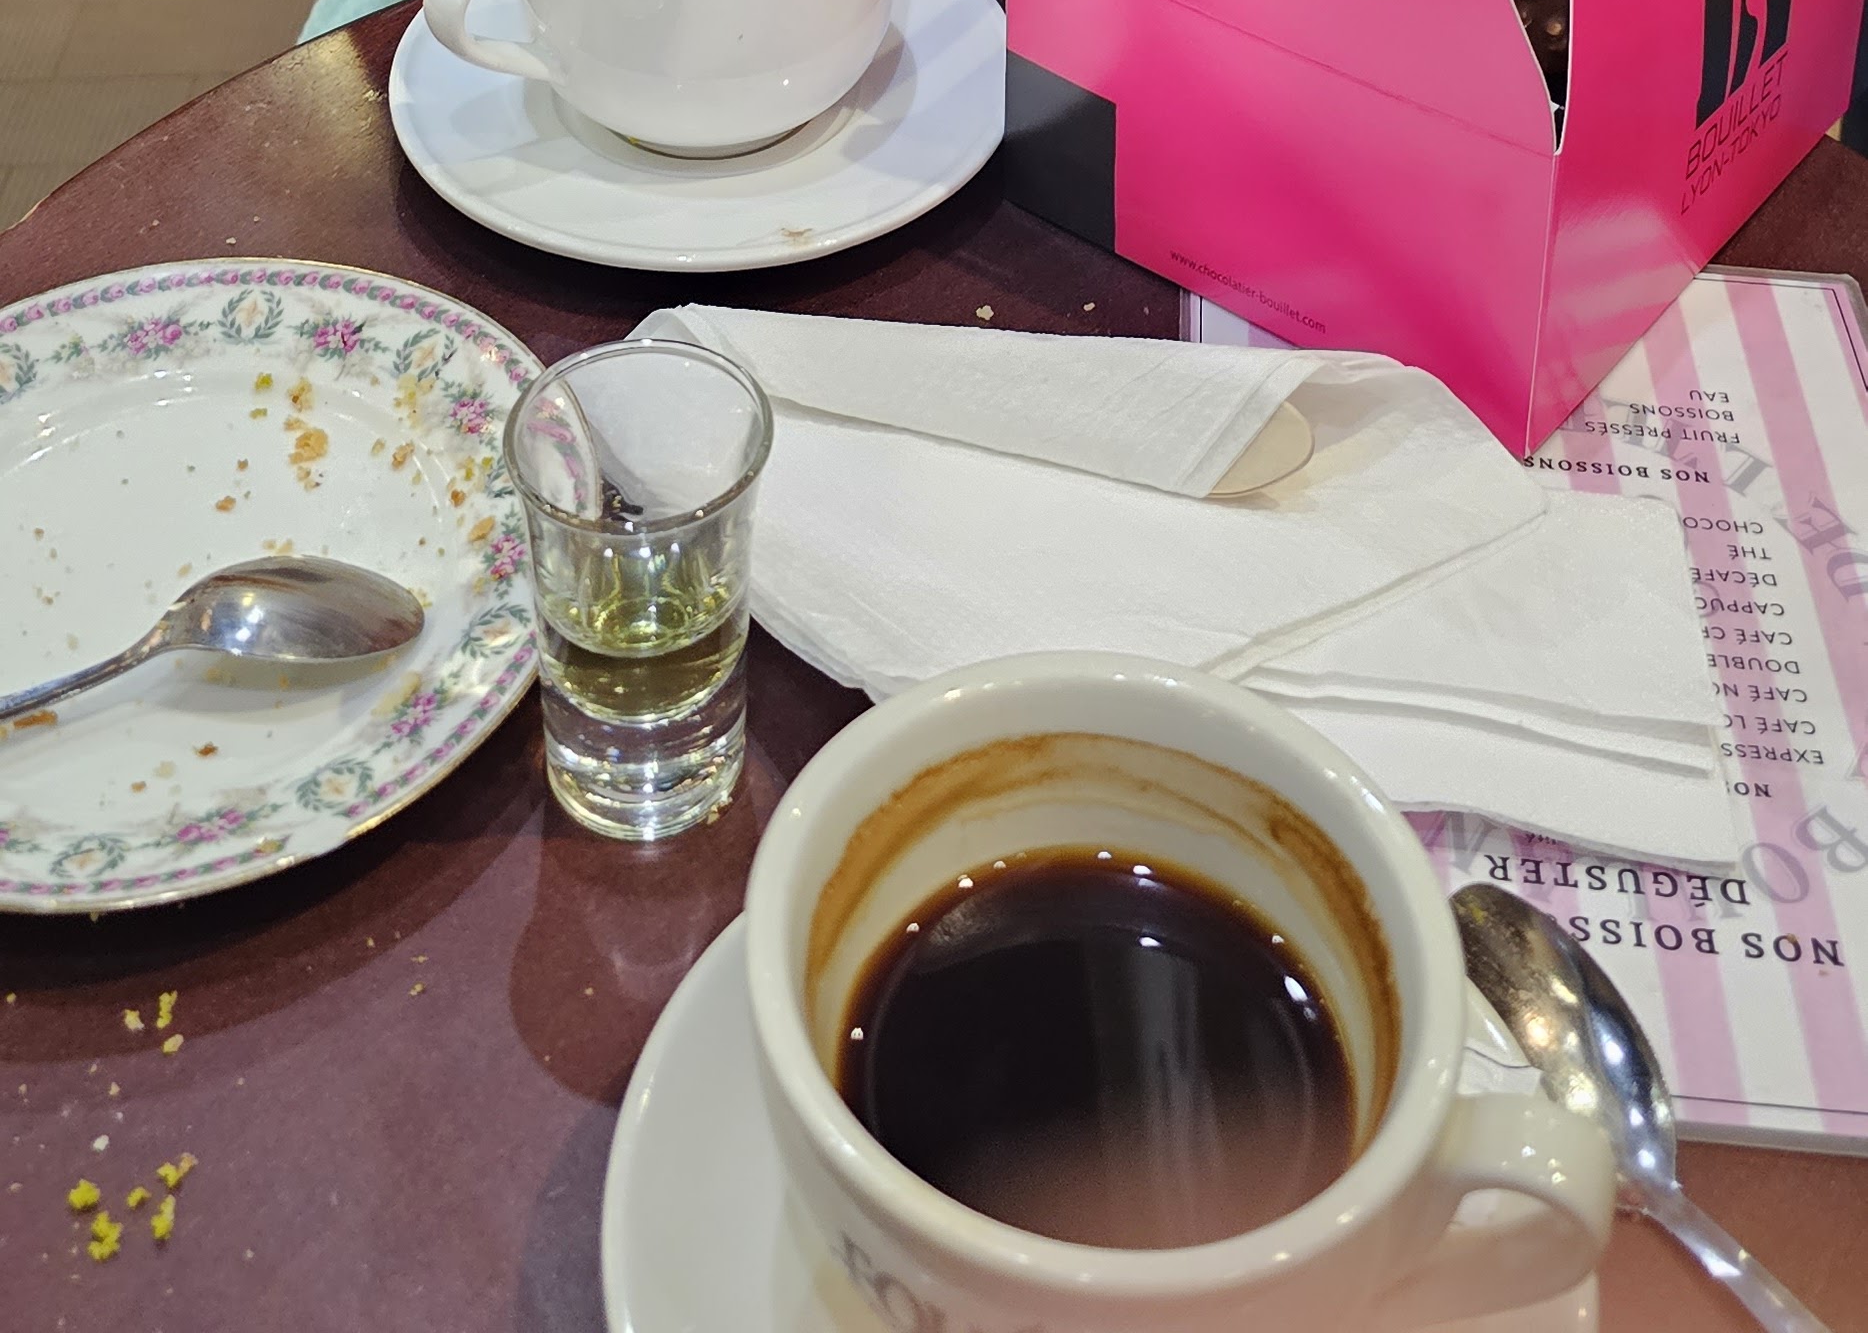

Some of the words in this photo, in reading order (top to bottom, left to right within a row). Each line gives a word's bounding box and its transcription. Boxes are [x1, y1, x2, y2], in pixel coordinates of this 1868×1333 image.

[1685, 50, 1788, 180] BOUILLET
[1680, 93, 1782, 216] LYON-TOKYO
[1169, 249, 1328, 335] www.chocolatier-bouillet.com
[1689, 389, 1730, 403] EAU
[1629, 402, 1735, 422] BOISSONS
[1585, 421, 1672, 438] PRESSÉS
[1681, 429, 1740, 444] FRUIT
[1523, 455, 1650, 478] BOISSONS
[1660, 468, 1710, 483] NOS
[1682, 516, 1764, 534] CHOCO
[1726, 544, 1772, 560] THÉ
[1689, 567, 1777, 588] DÉCAFÉ
[1734, 628, 1793, 645] CAFÉ
[1706, 653, 1801, 674] DOUBLE
[1747, 685, 1808, 703] CAFÉ
[1754, 716, 1816, 734] CAFÉ
[1720, 742, 1825, 764] EXPRESS
[1726, 780, 1773, 798] NO
[1483, 853, 1752, 909] DÉGUSTER
[1740, 932, 1846, 967] NOS
